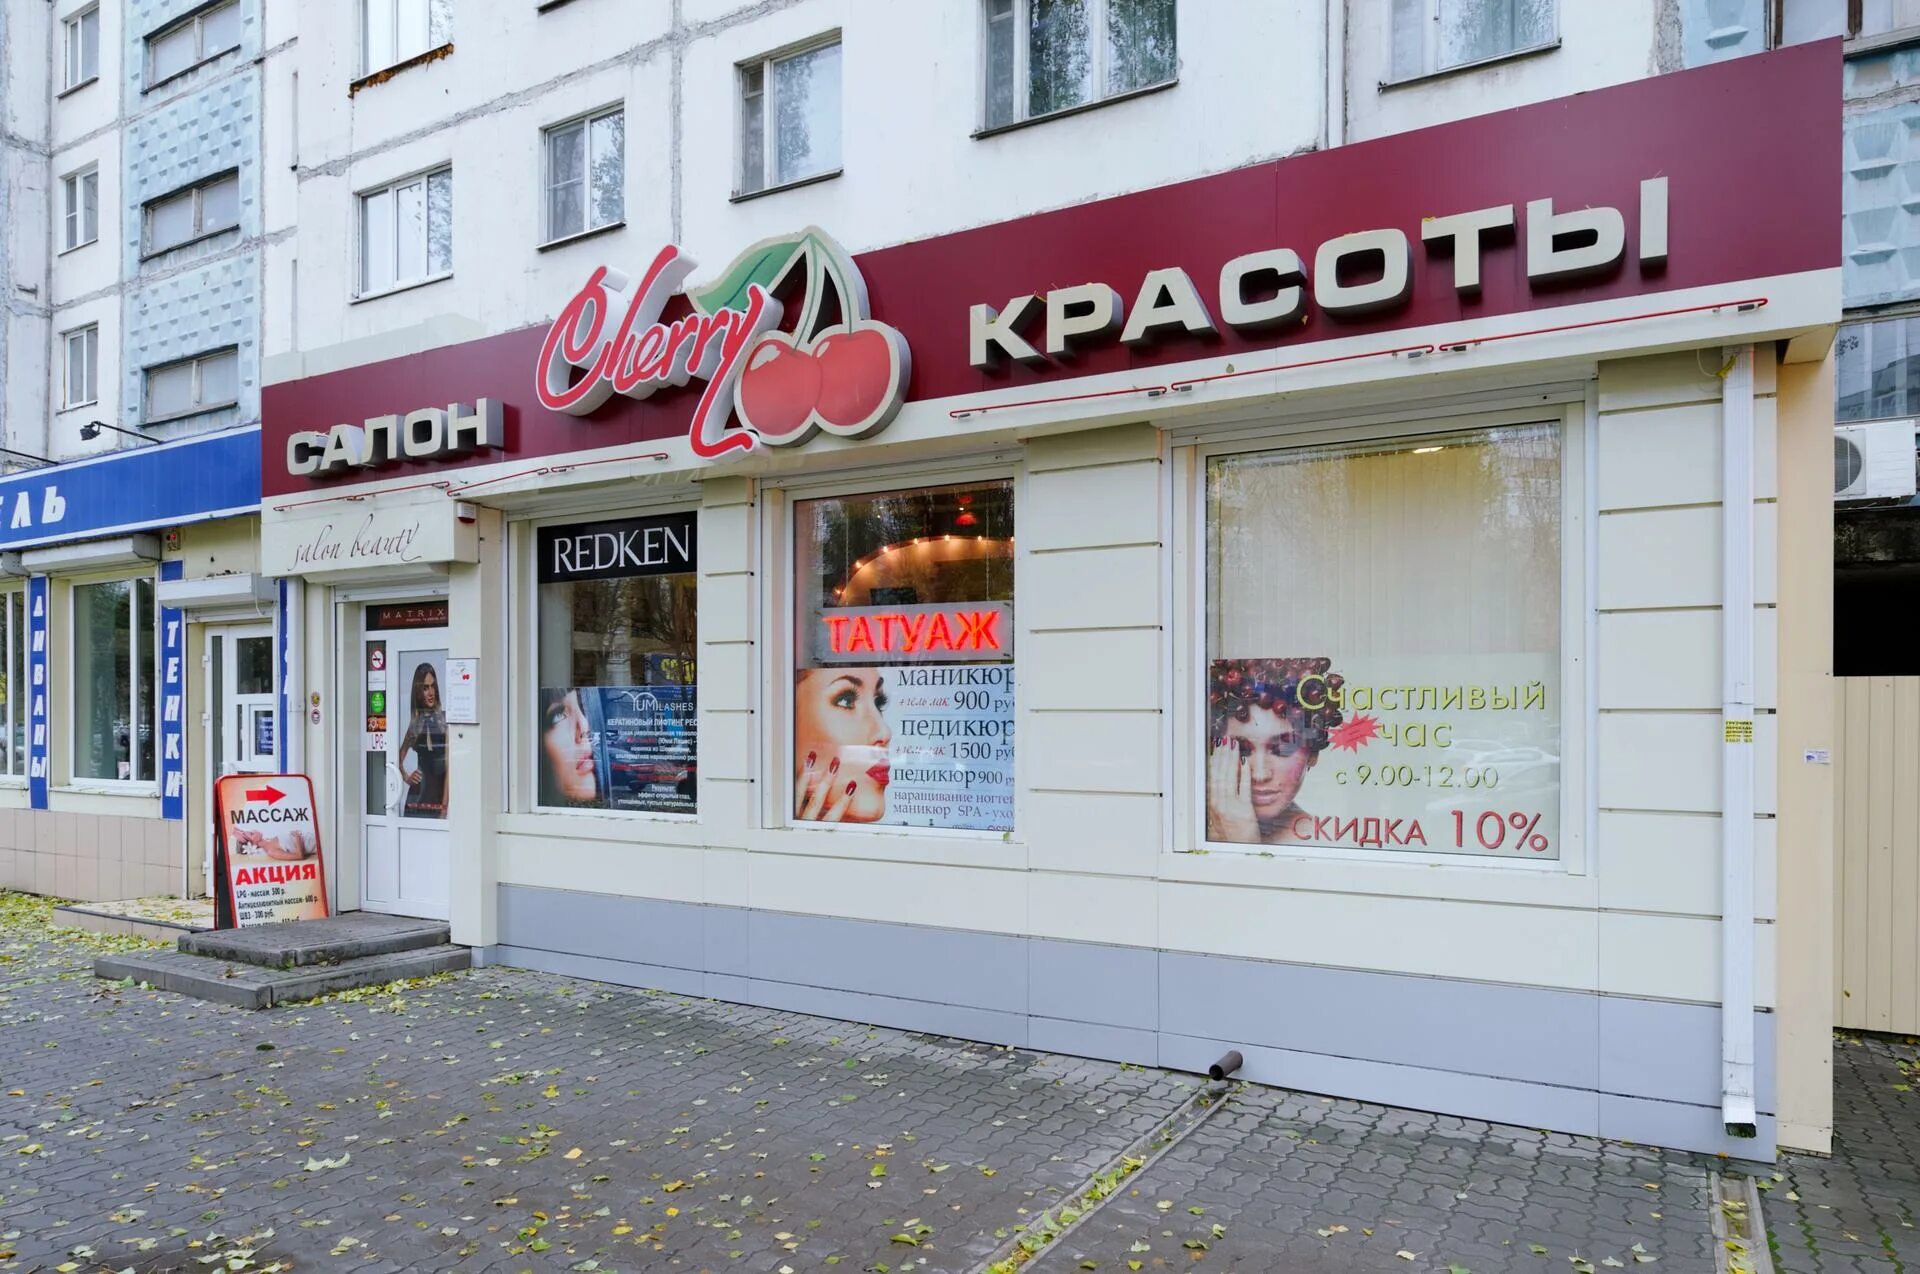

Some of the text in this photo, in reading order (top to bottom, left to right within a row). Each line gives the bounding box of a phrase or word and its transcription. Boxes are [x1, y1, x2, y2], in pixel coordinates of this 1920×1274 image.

[970, 176, 1669, 371] КРАСОТЫ
[536, 243, 764, 460] Cherry
[287, 397, 497, 475] САЛОН
[0, 485, 66, 529] ЛЬ
[287, 513, 422, 571] salon beauty
[553, 525, 691, 574] REDKEN
[382, 608, 445, 621] MATRIX
[823, 611, 1000, 653] ТАТУАЖ
[31, 595, 47, 778] ДИВАНЫ
[897, 667, 1015, 693] маникюр
[1296, 674, 1546, 711] Счастливый
[164, 606, 183, 798] ТЕНКИ
[954, 690, 990, 710] 900
[994, 699, 1015, 713] ру
[900, 719, 1015, 745] педикюр
[1379, 721, 1454, 747] час
[950, 742, 991, 759] 1500
[893, 768, 976, 788] педикюр
[978, 771, 1003, 785] 900
[1356, 762, 1499, 789] 9.00-12.00
[230, 807, 309, 825] МАССАЖ
[893, 803, 952, 819] маникюр
[958, 805, 982, 817] SPA
[1292, 809, 1549, 852] СКИДКА 10%
[235, 863, 316, 886] АКЦИЯ
[236, 890, 247, 899] LPG
